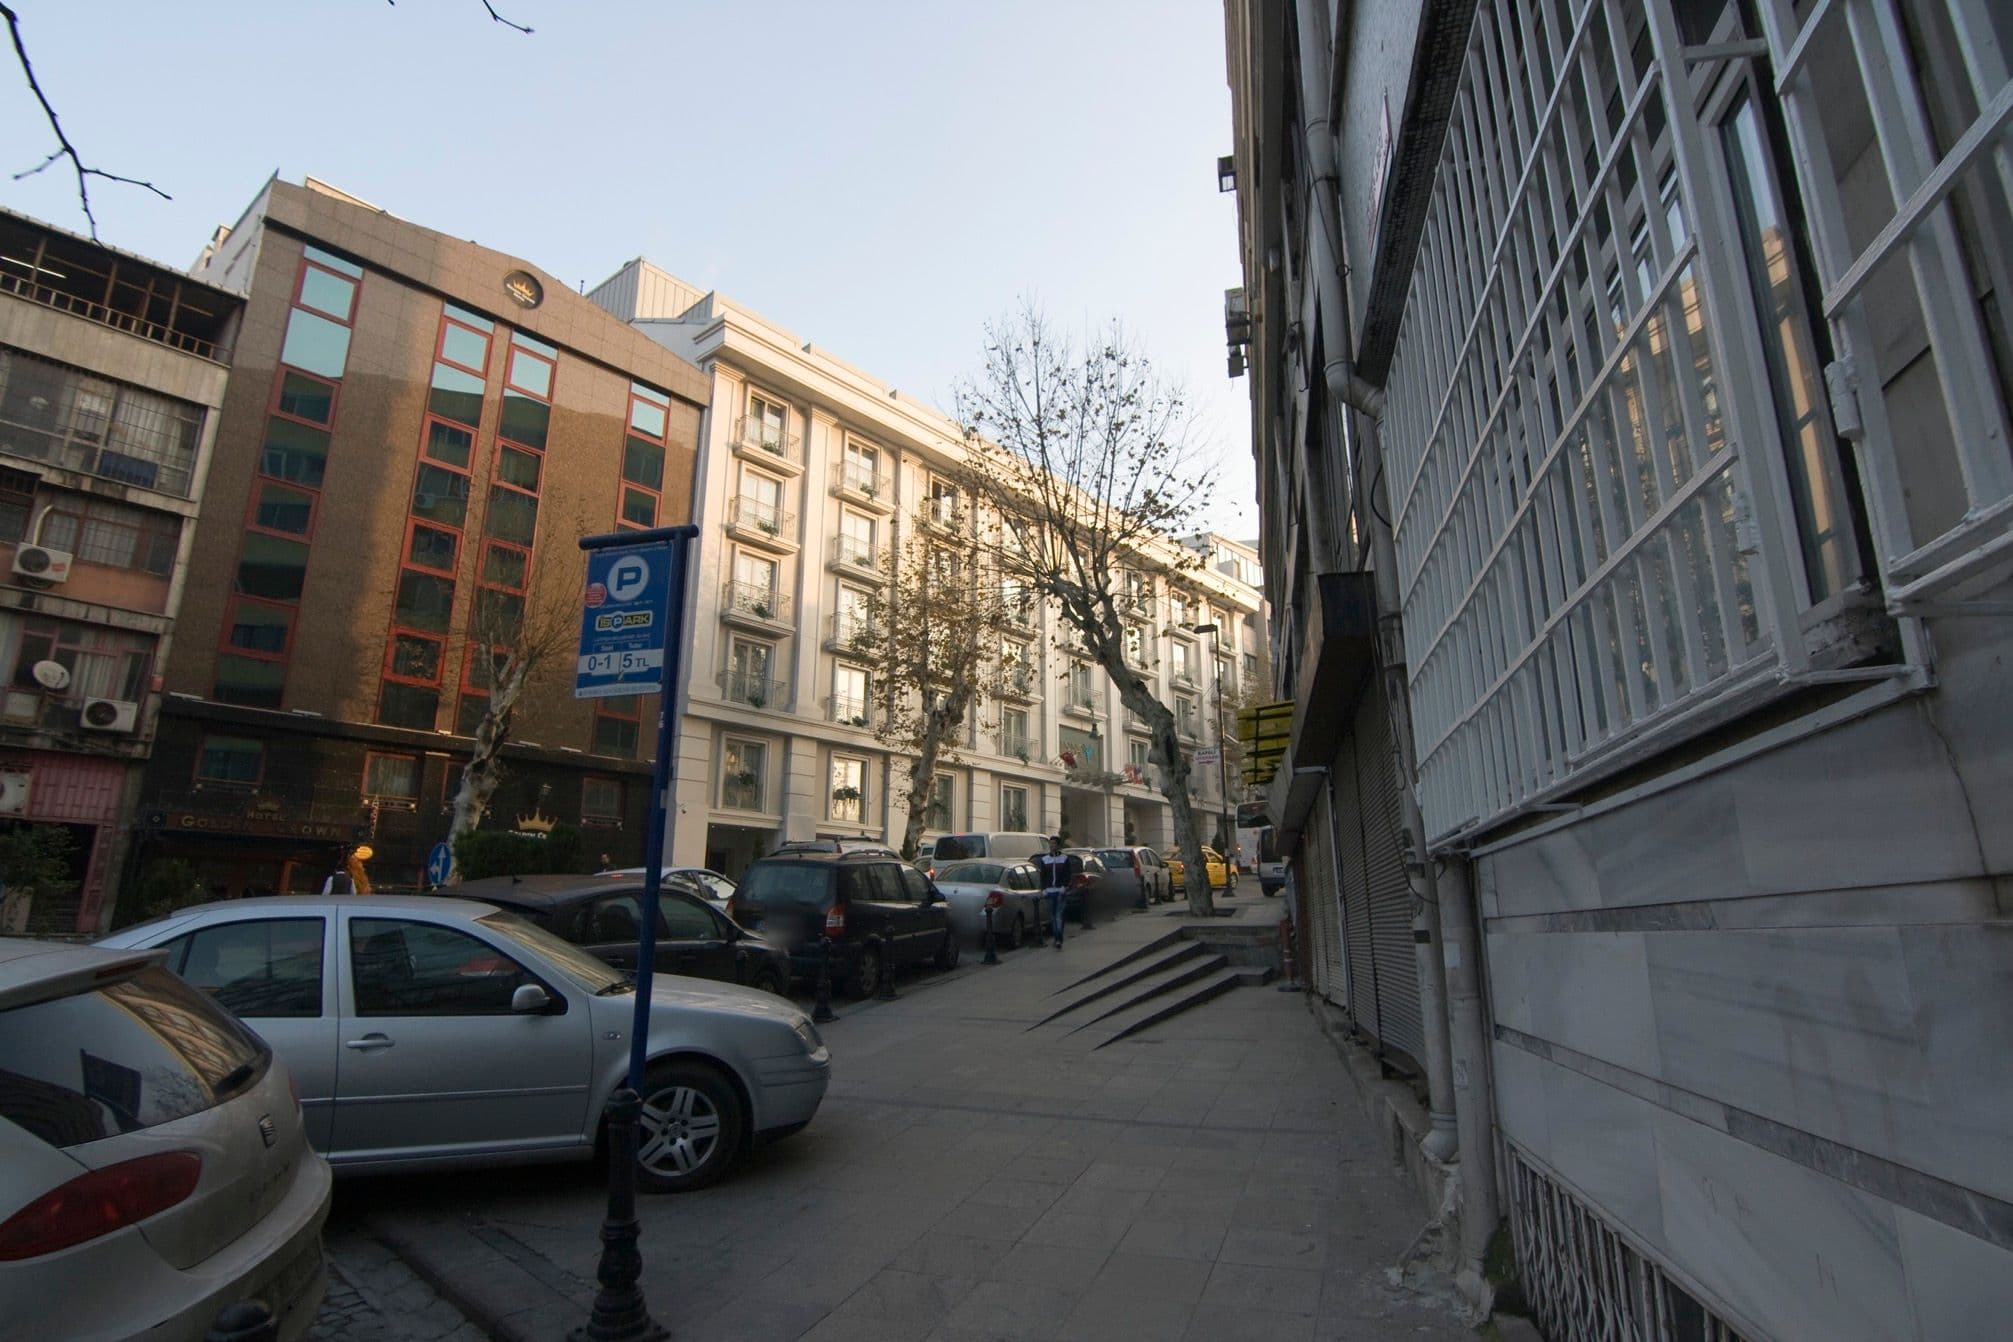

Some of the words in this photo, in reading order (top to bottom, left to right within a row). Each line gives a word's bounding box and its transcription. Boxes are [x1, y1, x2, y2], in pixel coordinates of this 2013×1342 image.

[616, 566, 642, 591] P
[588, 655, 612, 671] 0-1
[622, 653, 633, 669] 5
[635, 657, 650, 668] TL
